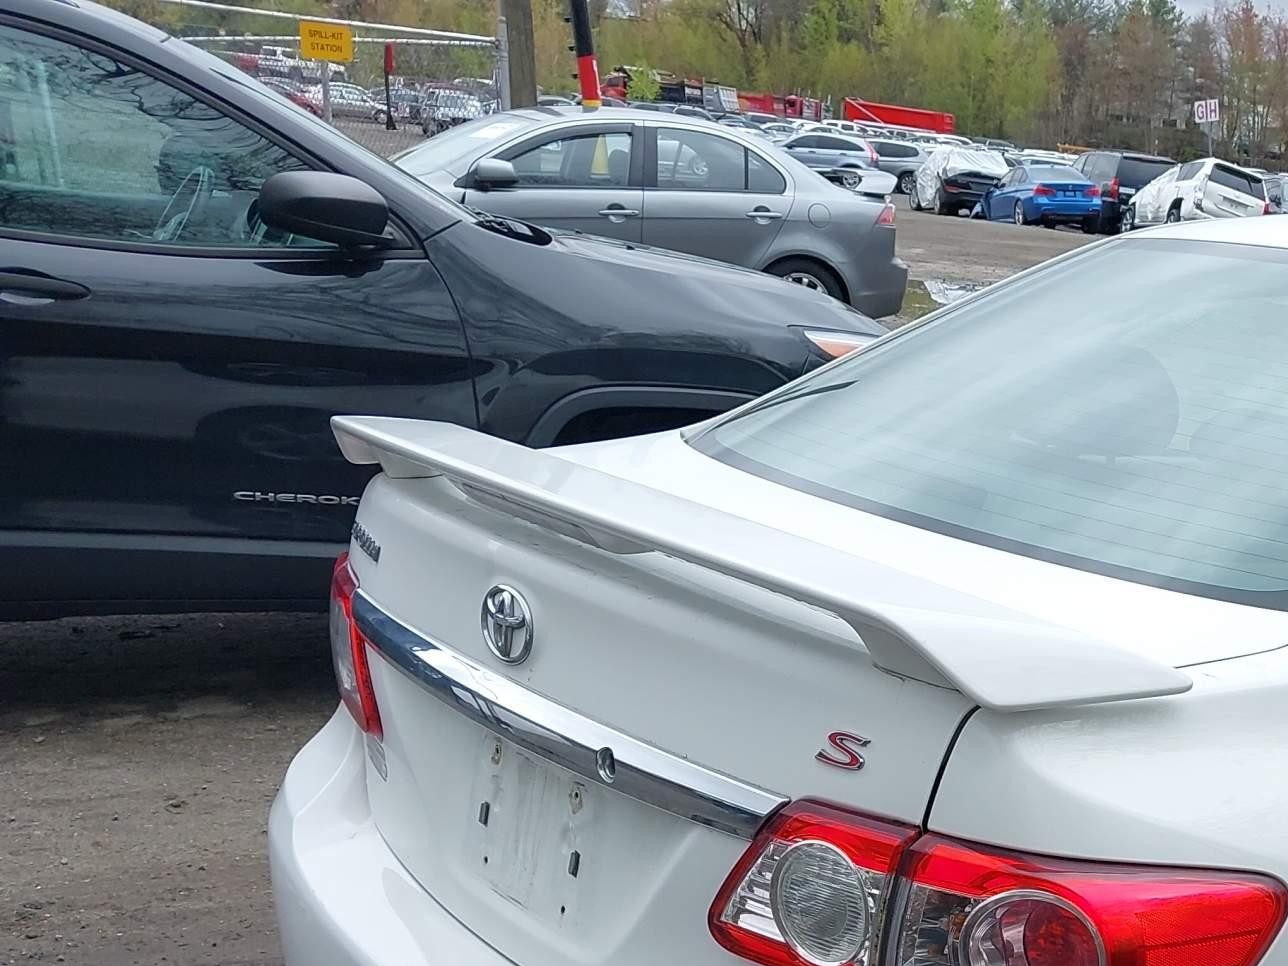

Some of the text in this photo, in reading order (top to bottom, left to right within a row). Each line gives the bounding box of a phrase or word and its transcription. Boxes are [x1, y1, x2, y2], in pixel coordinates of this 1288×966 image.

[308, 29, 344, 40] SPILL-KIT
[311, 42, 343, 53] STATION
[1210, 101, 1217, 119] H
[814, 730, 871, 771] S
